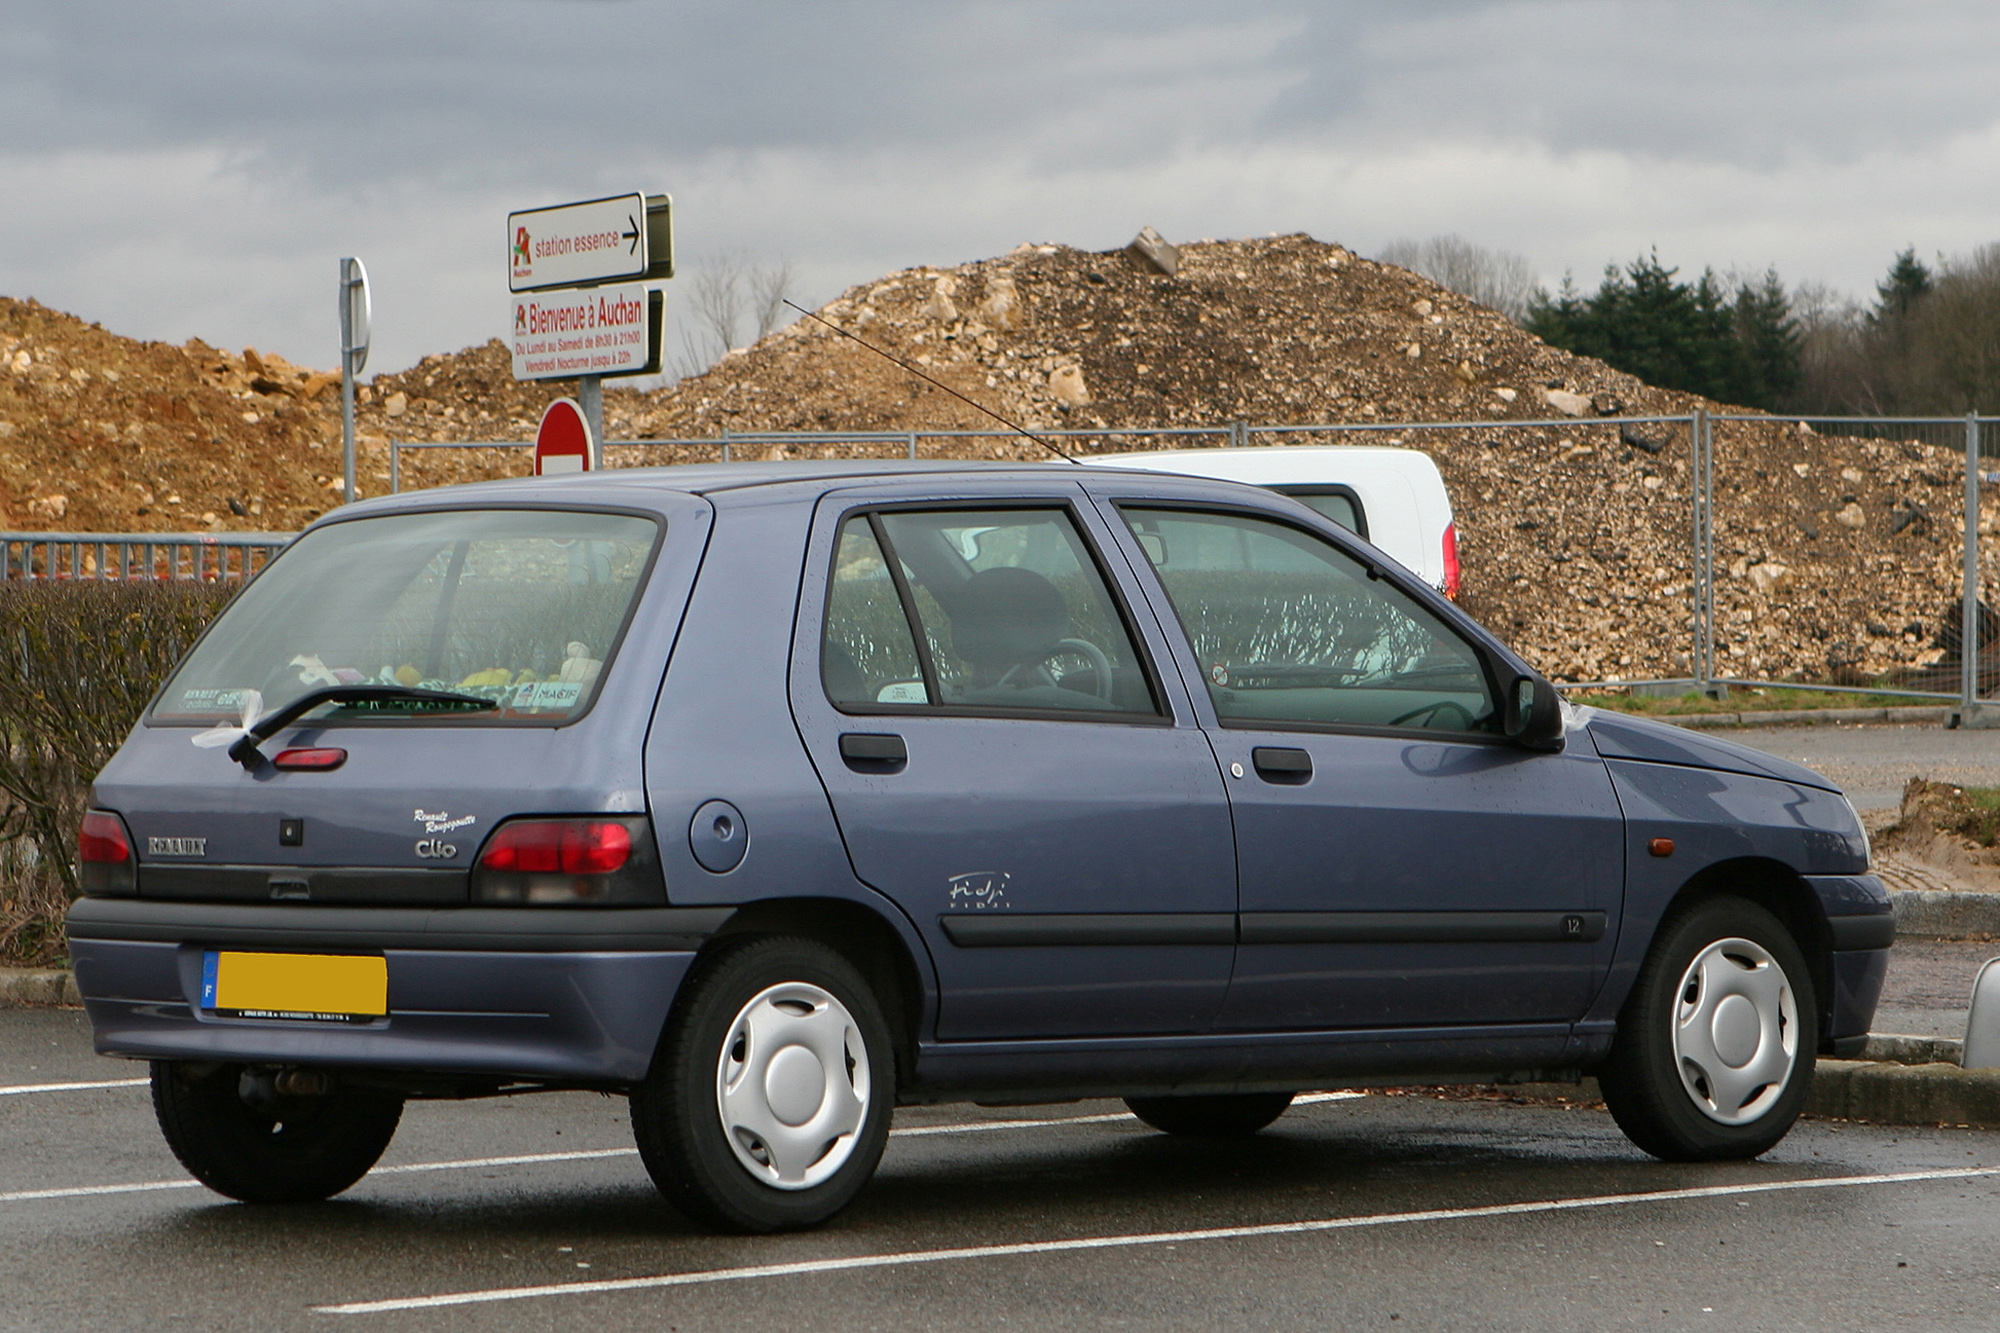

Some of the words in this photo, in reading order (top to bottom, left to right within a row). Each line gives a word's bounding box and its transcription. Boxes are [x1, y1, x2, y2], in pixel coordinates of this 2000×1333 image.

[535, 235, 571, 258] station
[574, 231, 619, 252] essence
[514, 269, 532, 278] Auchan
[530, 302, 586, 334] Bienvenue
[589, 296, 595, 328] à
[598, 293, 641, 327] Auchan
[515, 342, 525, 356] Du
[527, 340, 546, 355] Lundi
[548, 342, 556, 352] au
[558, 338, 583, 352] Samedi
[585, 336, 593, 349] de
[595, 333, 612, 348] 8h30
[620, 330, 640, 345] 21h00
[525, 357, 555, 373] Vendredi
[557, 355, 588, 370] Nocturne
[618, 350, 631, 364] 22h
[414, 809, 448, 821] Renault
[148, 837, 207, 856] RENAULT
[415, 839, 457, 859] Clio
[205, 985, 212, 998] F
